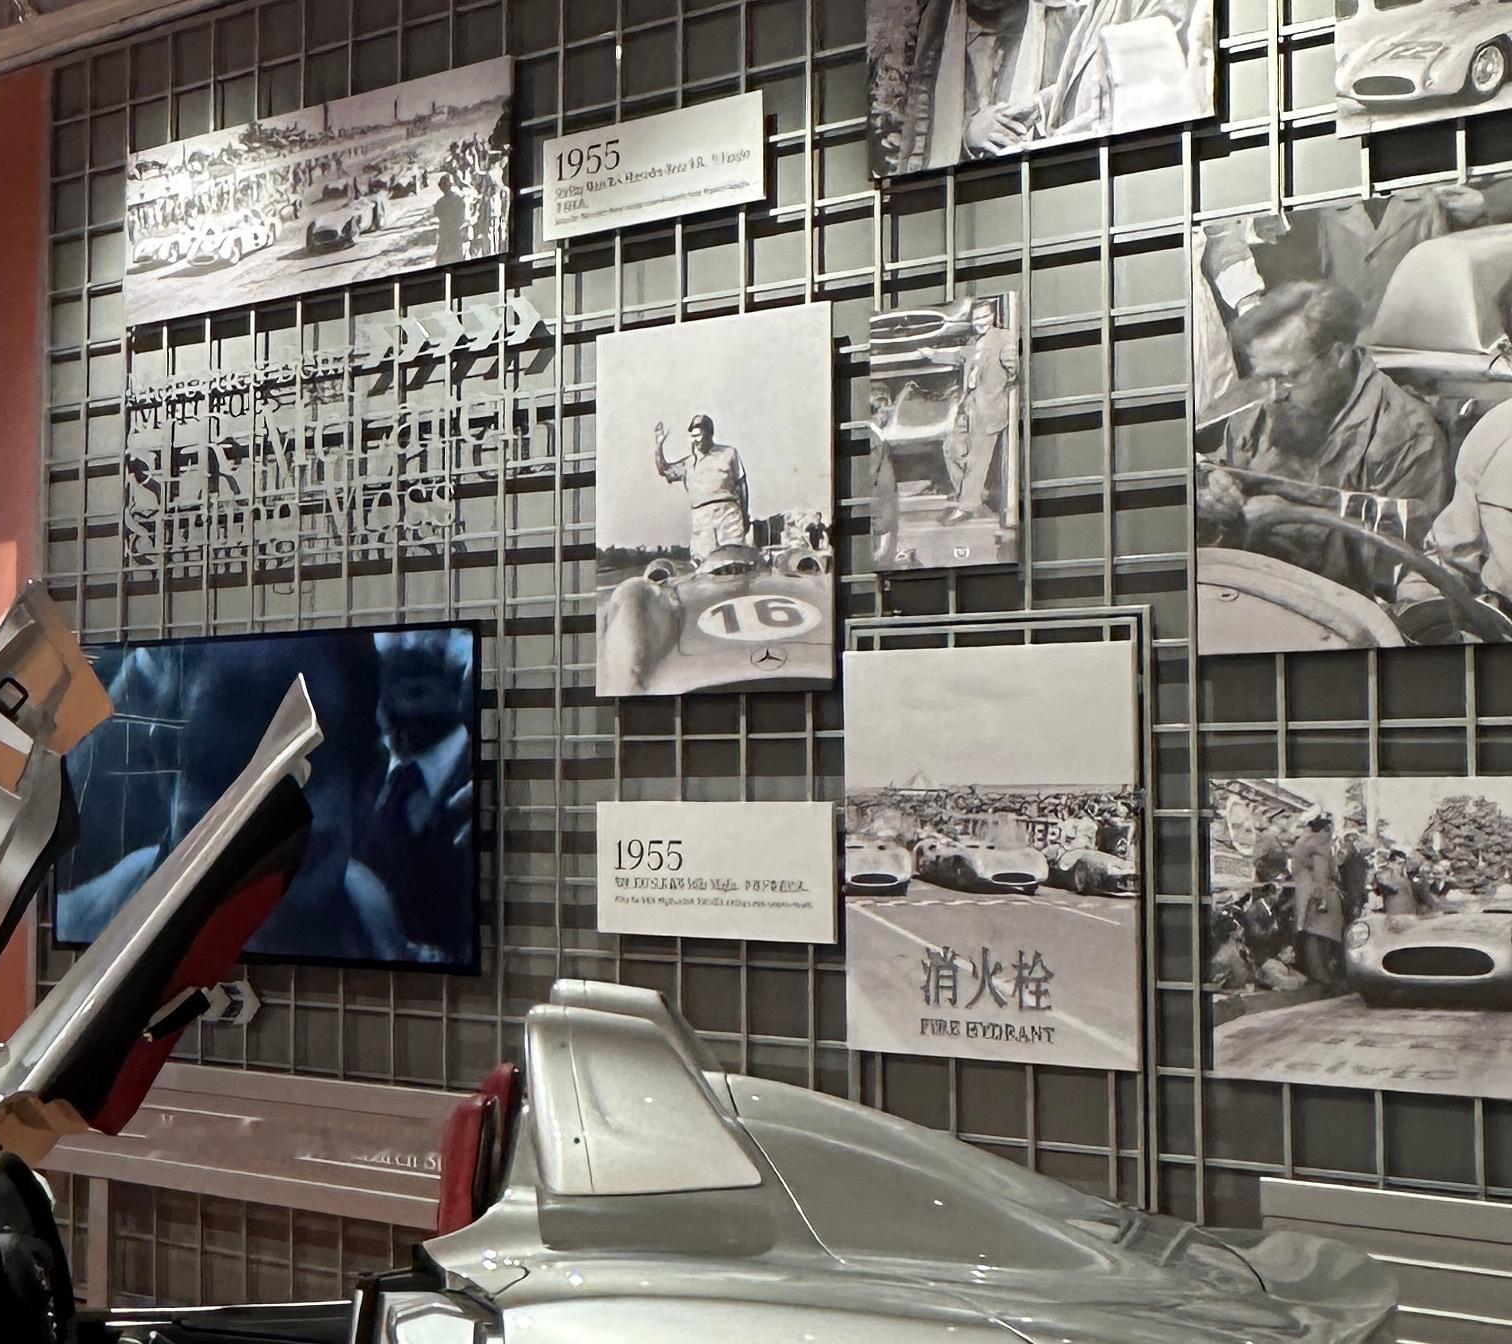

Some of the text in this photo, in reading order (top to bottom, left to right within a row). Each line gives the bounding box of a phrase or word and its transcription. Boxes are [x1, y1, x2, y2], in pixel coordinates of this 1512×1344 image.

[555, 139, 621, 182] 1955
[710, 597, 801, 635] 16
[614, 838, 684, 872] 1955
[920, 945, 1055, 1012] 消火栓
[920, 1017, 1055, 1044] FIRE HYDRANT
